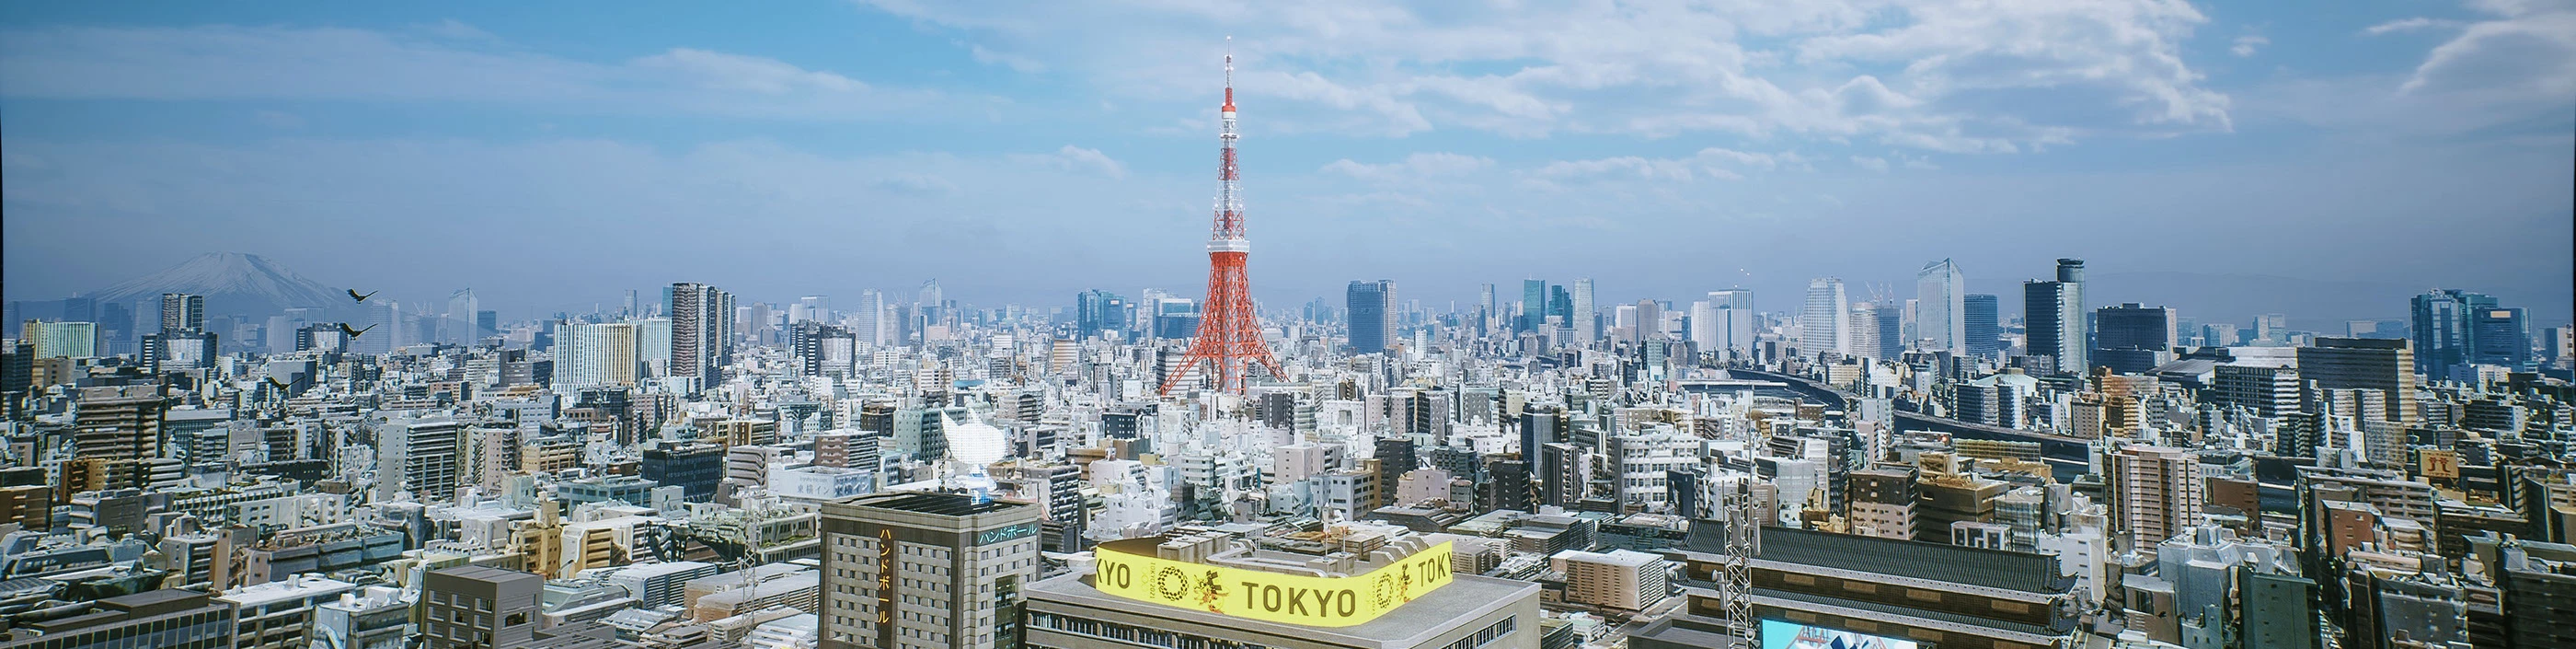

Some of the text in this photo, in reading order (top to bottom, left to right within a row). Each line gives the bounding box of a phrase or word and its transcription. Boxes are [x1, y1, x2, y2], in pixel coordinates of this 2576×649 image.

[979, 523, 1038, 544] ハンドボール
[878, 528, 891, 624] ハンドボール
[1241, 581, 1356, 618] TOKYO
